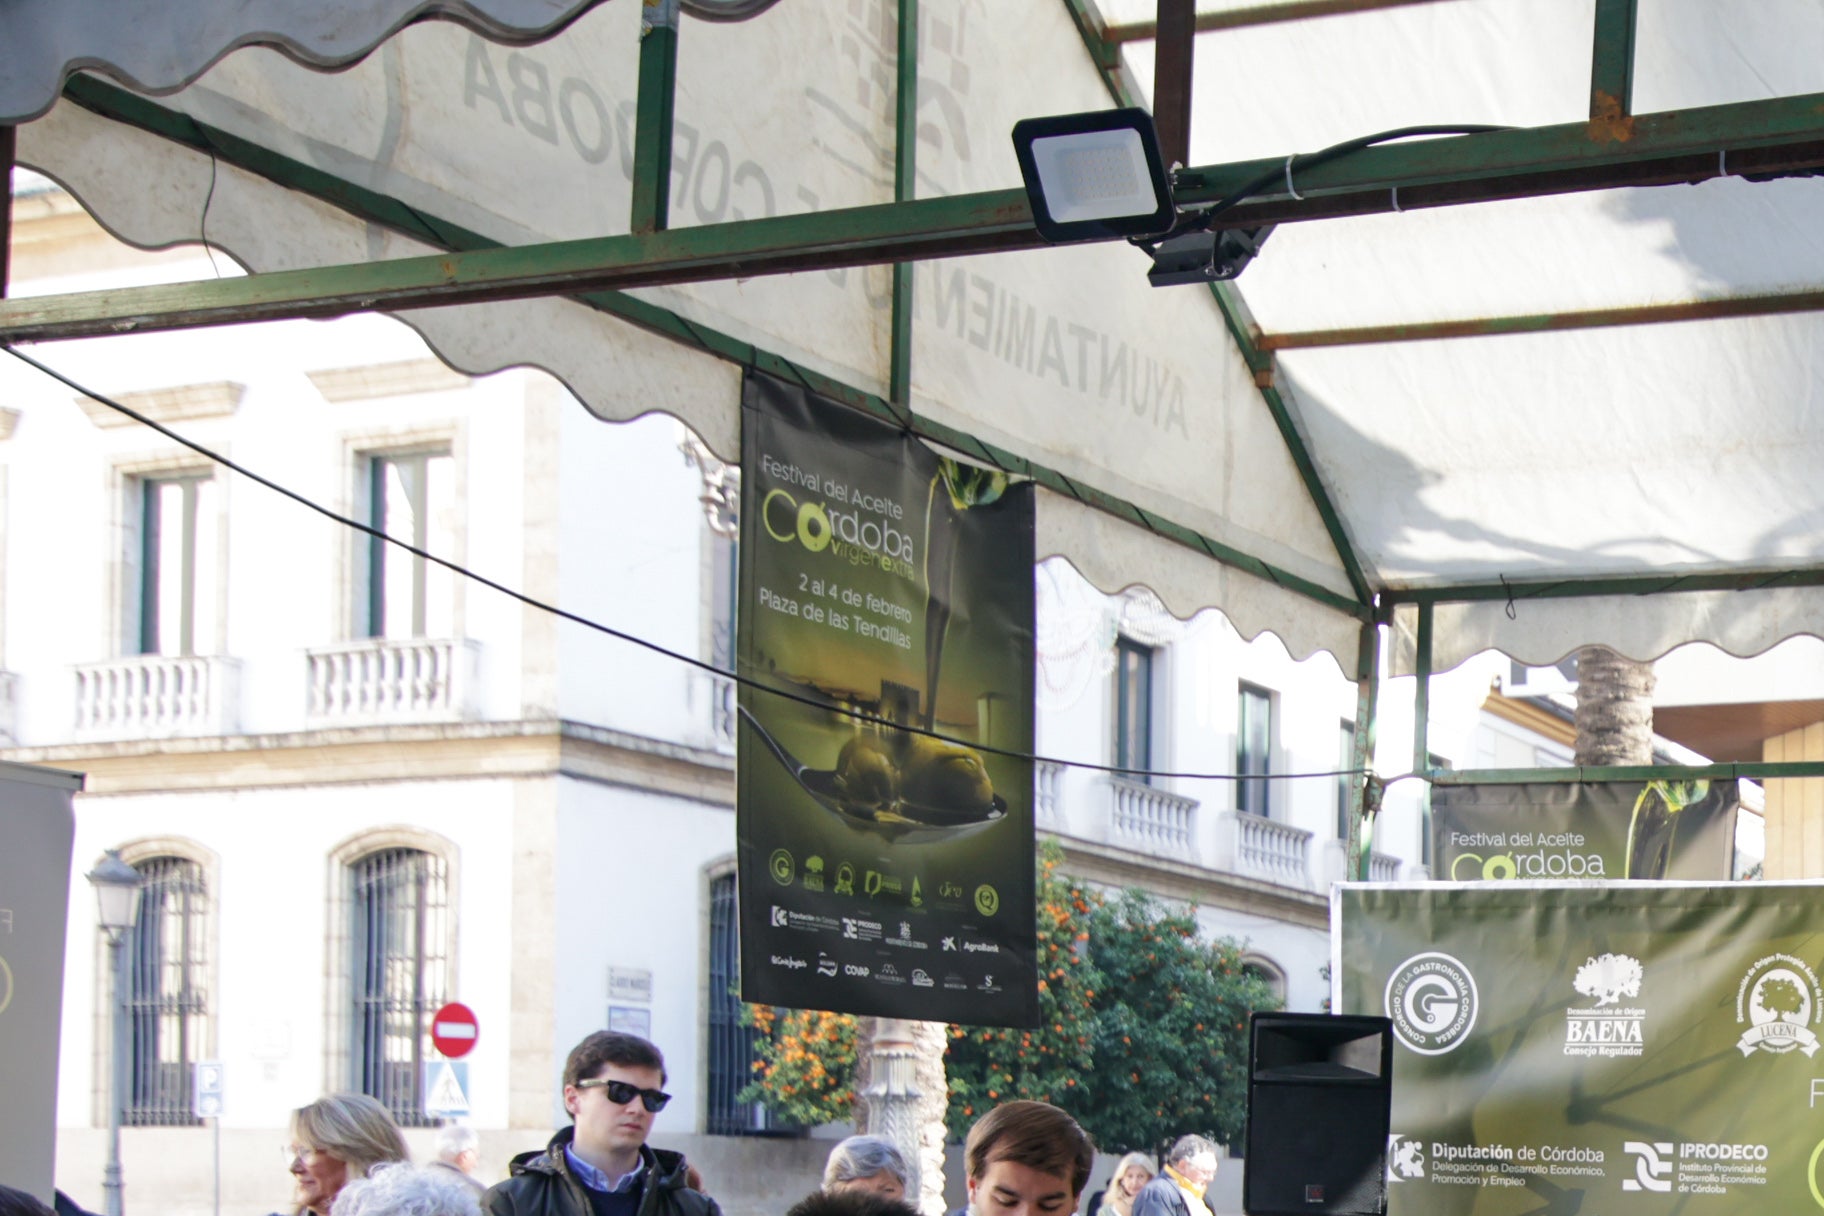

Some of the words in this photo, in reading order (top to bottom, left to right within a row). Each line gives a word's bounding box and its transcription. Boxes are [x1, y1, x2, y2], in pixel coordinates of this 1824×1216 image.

[762, 454, 820, 493] Festival
[824, 478, 848, 501] del
[852, 489, 904, 520] Aceite
[762, 488, 914, 565] Córdoba
[831, 540, 915, 581] virgenextra
[799, 573, 808, 592] 2
[811, 579, 825, 597] al
[828, 583, 838, 599] 4
[842, 589, 862, 608] de
[866, 594, 912, 624] febrero
[760, 587, 798, 617] Plaza
[803, 602, 824, 623] de
[829, 609, 849, 630] las
[853, 615, 912, 650] Tendillas
[1451, 832, 1506, 847] Festival
[1510, 832, 1533, 847] del
[1537, 832, 1585, 847] Aceite
[1451, 849, 1605, 881] Córdoba
[963, 942, 999, 953] AgroBank
[1403, 972, 1414, 983] LA
[1413, 962, 1468, 996] GASTRONOMÍA
[1395, 983, 1405, 995] DE
[1614, 1007, 1623, 1015] de
[1624, 1007, 1646, 1016] Origen
[1394, 997, 1426, 1043] CONSORCIO
[1435, 997, 1469, 1044] CORDOBESA
[1566, 1020, 1643, 1042] BAENA
[1760, 1025, 1797, 1037] LUCENA
[1563, 1046, 1597, 1058] Consejo
[1599, 1046, 1643, 1058] Regulador
[1432, 1142, 1513, 1160] Diputación
[1517, 1146, 1536, 1161] de
[1541, 1145, 1605, 1162] Córdoba
[1680, 1143, 1768, 1160] IPRODECO
[1432, 1161, 1484, 1173] Delegación
[1486, 1163, 1499, 1173] de
[1501, 1163, 1548, 1174] Desarrollo
[1679, 1162, 1712, 1172] Instituto
[1714, 1163, 1754, 1173] Provincial
[1755, 1164, 1767, 1174] de
[1432, 1174, 1480, 1184] Promoción
[1490, 1176, 1526, 1187] Empleo
[1678, 1173, 1719, 1183] Desarrollo
[1721, 1174, 1766, 1184] Económico
[1678, 1183, 1689, 1193] de
[1691, 1183, 1726, 1194] Córdoba
